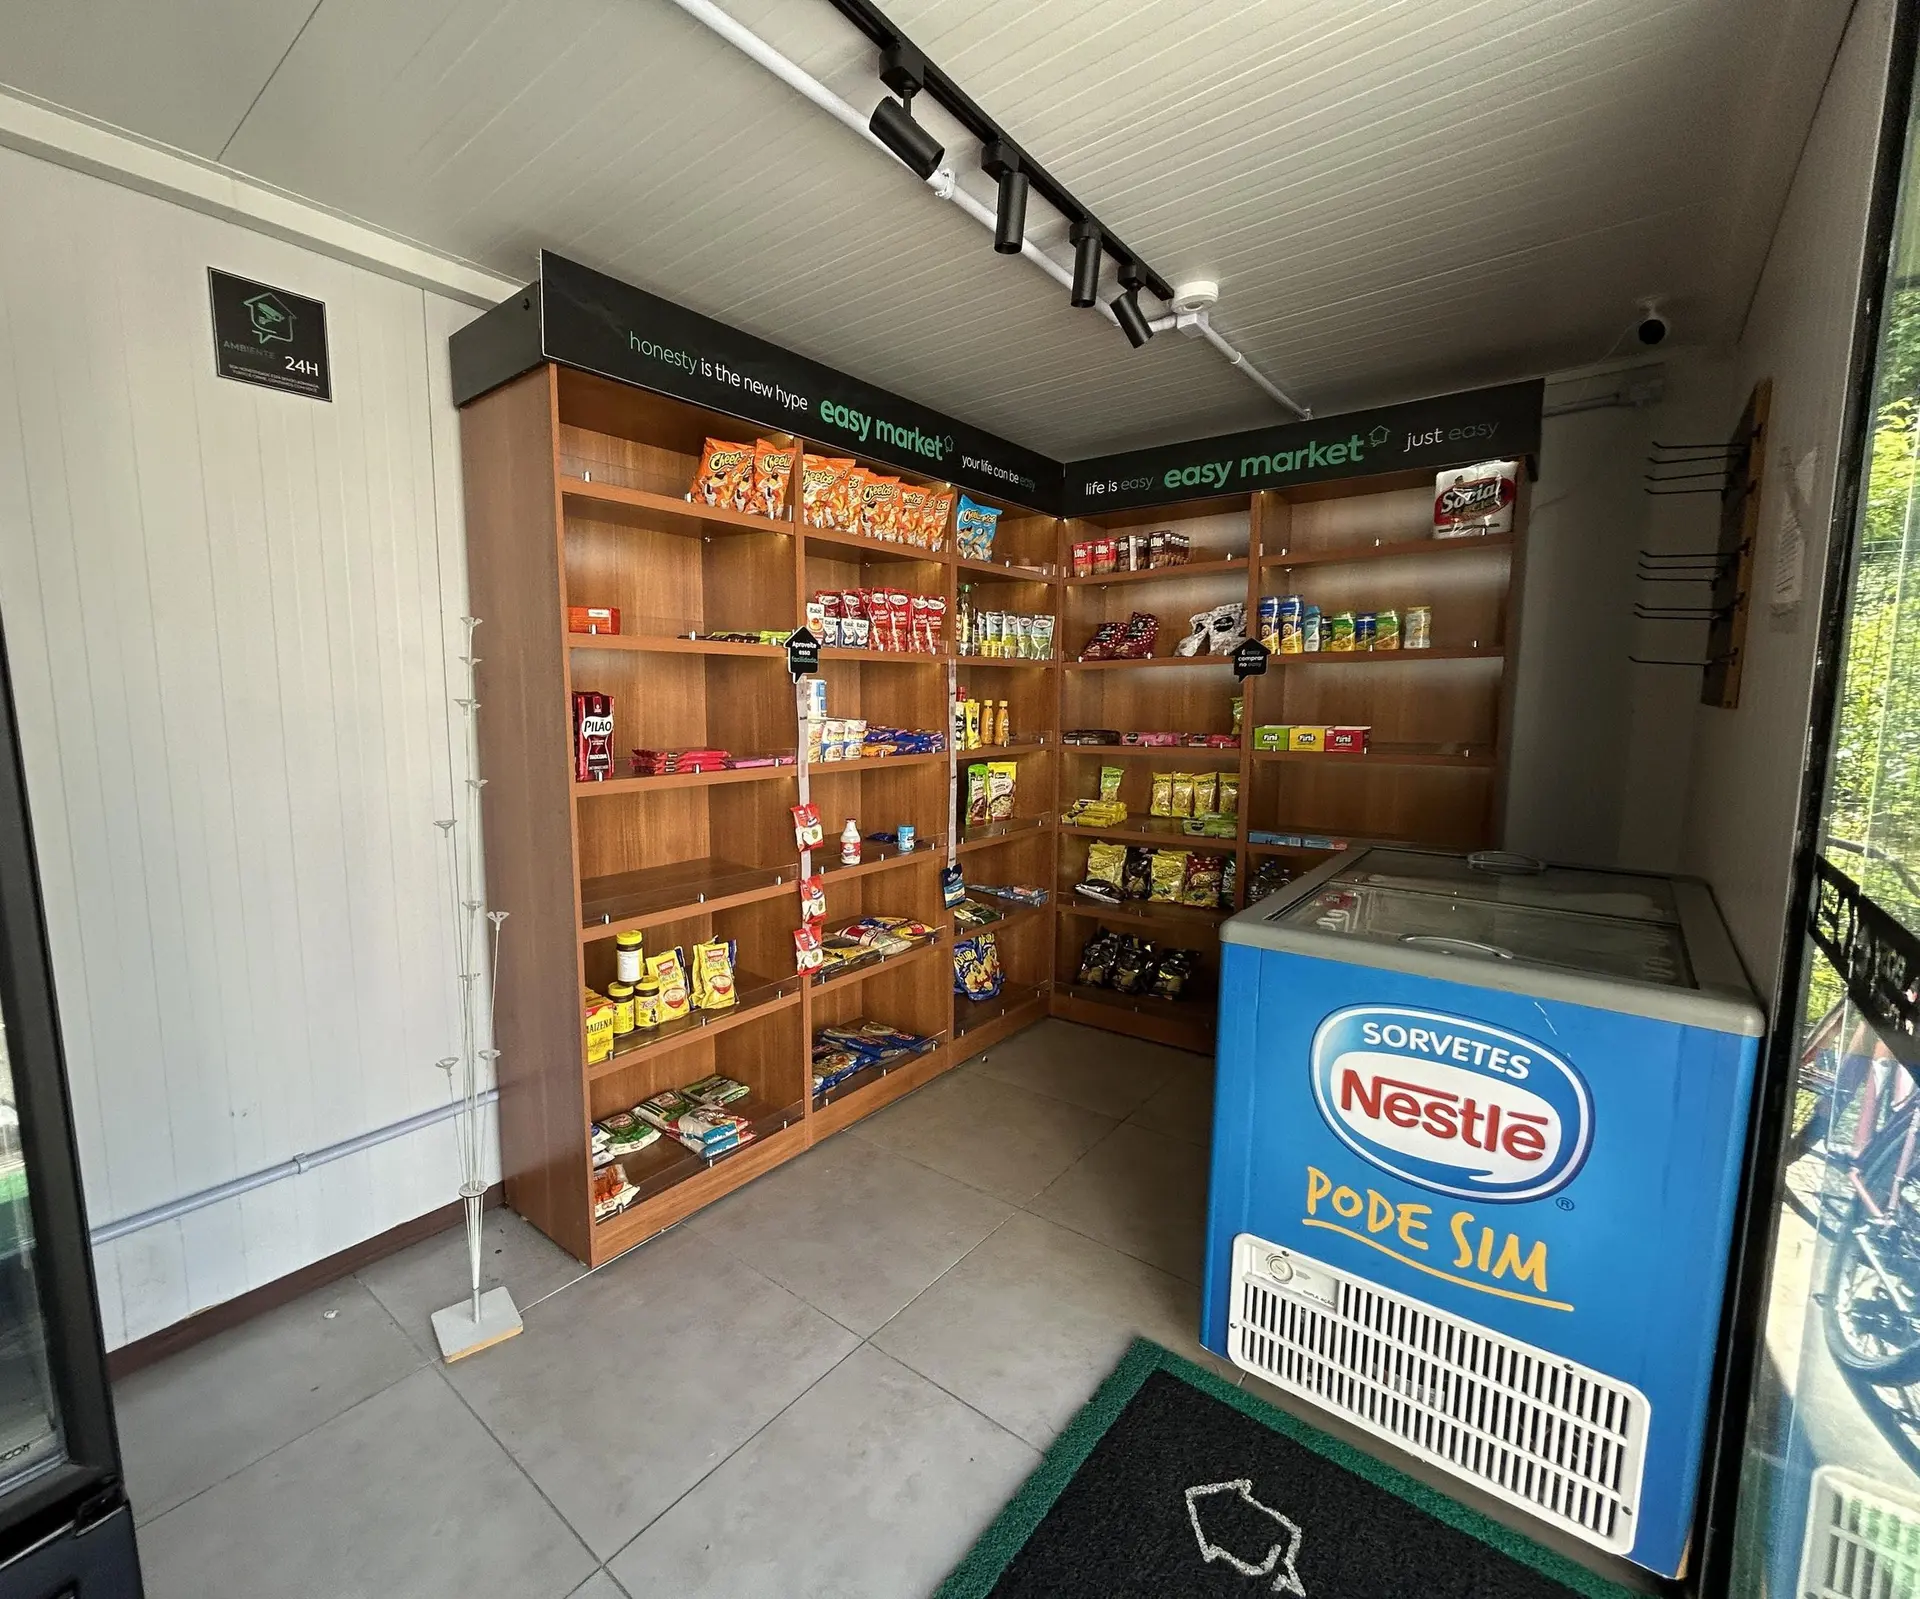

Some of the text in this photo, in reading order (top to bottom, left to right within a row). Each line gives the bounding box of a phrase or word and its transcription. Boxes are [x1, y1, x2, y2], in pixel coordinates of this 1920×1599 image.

[223, 341, 276, 360] AMBIENTE
[284, 355, 319, 377] 24H
[630, 330, 808, 410] honesty is the new hype
[820, 399, 942, 461] easy market
[1403, 421, 1500, 453] just easy
[962, 454, 980, 471] your
[980, 458, 992, 476] life
[993, 467, 1008, 480] can
[1009, 471, 1020, 484] be
[1164, 434, 1365, 489] easy market
[862, 484, 893, 501] Cheetos
[1085, 476, 1154, 496] life is easy
[584, 719, 612, 732] PILÃO
[1363, 1022, 1531, 1080] SORVETES
[1340, 1068, 1548, 1161] Nestlé
[1307, 1165, 1548, 1292] PODE SIM
